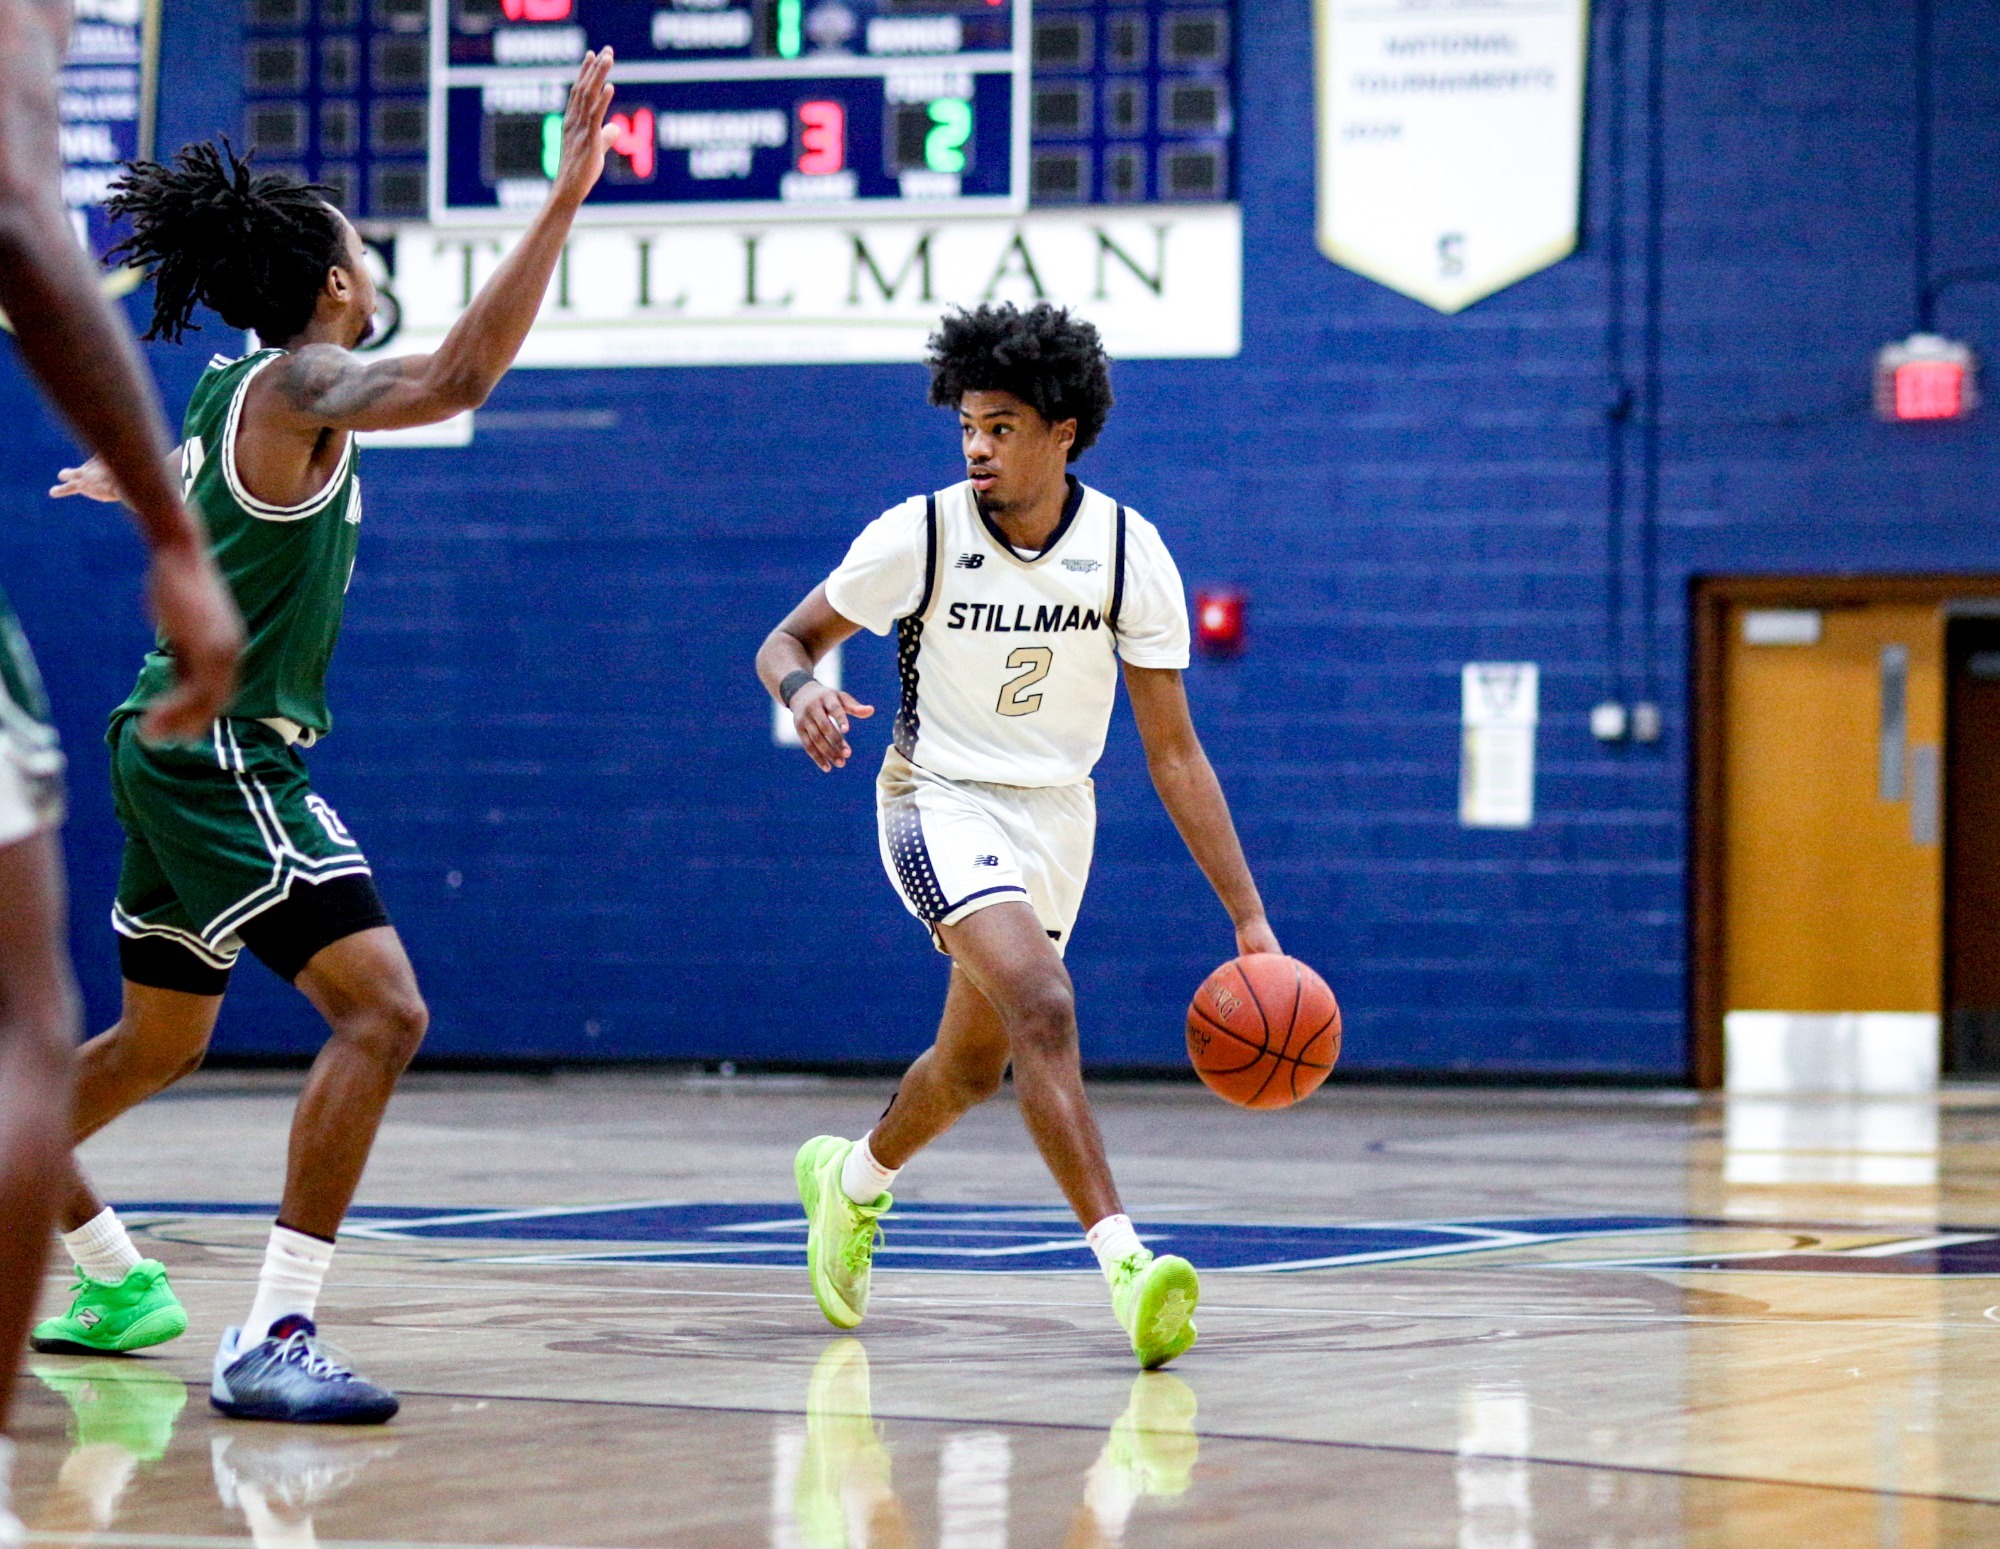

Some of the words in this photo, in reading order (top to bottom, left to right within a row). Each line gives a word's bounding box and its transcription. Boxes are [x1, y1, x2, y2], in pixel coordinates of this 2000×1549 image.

[610, 107, 655, 179] 4
[798, 100, 844, 175] 3
[924, 98, 972, 173] 2
[947, 602, 1101, 633] STILLMAN
[996, 646, 1054, 717] 2
[76, 1307, 102, 1331] N
